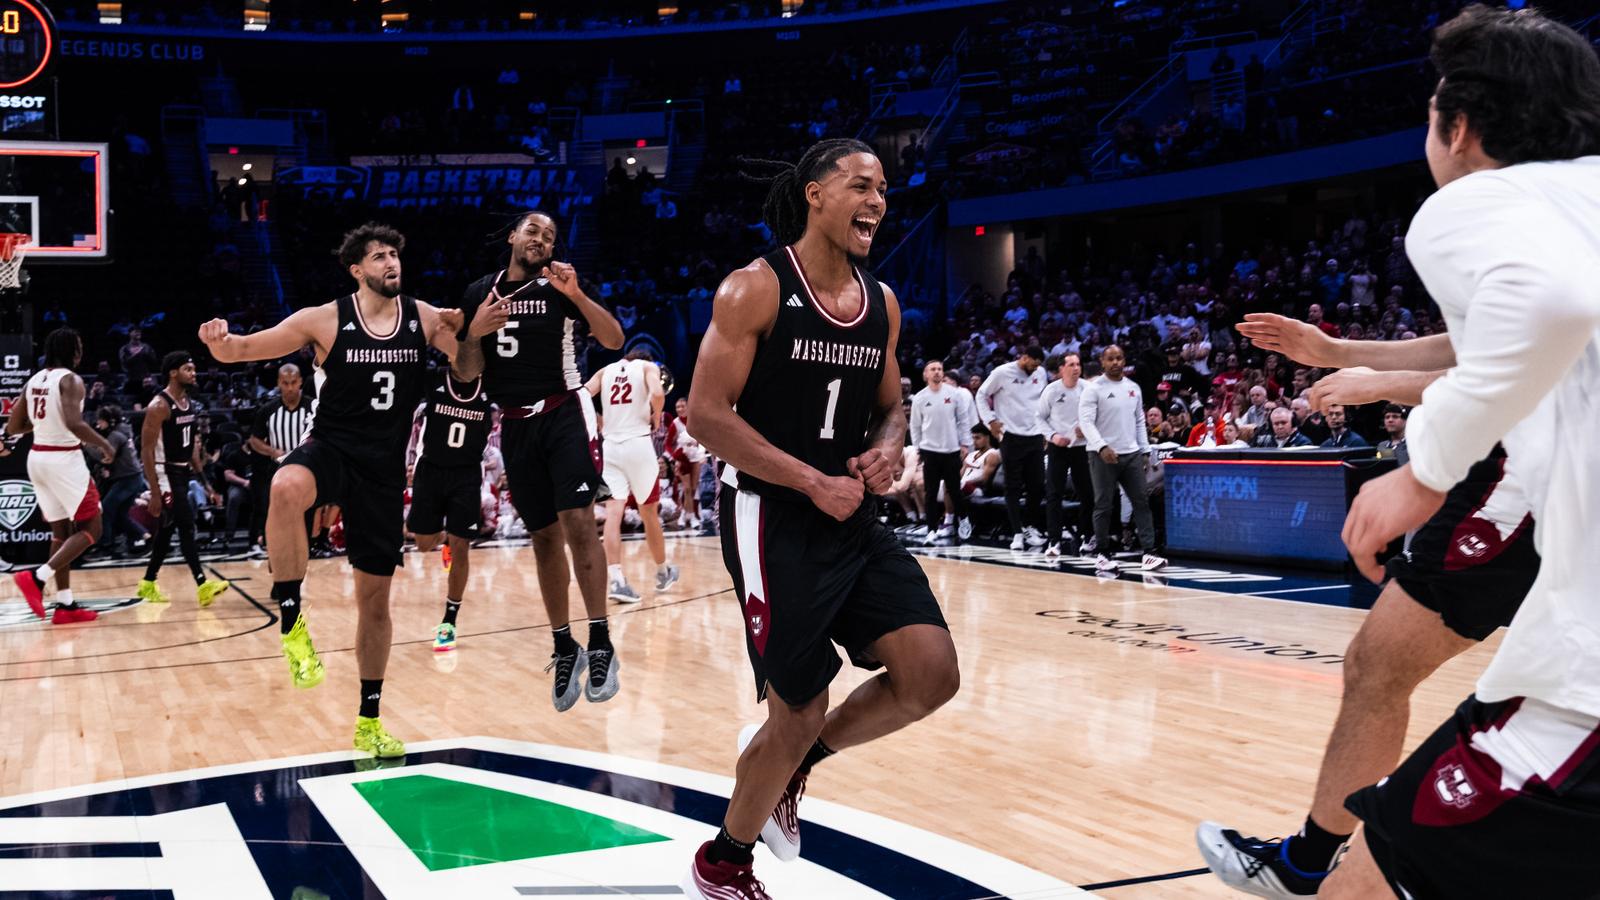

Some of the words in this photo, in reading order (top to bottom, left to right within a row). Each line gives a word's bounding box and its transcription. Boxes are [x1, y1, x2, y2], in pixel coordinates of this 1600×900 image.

[61, 40, 143, 59] EGENDS
[151, 43, 205, 60] CLUB
[382, 168, 577, 193] BASKETBALL
[496, 321, 520, 357] 5
[346, 349, 419, 363] MASSACHUSETTS
[791, 338, 881, 369] MASSACHUSETTS
[371, 371, 395, 410] 3
[610, 382, 632, 405] 22
[33, 397, 46, 419] 13
[435, 403, 485, 421] MASSACHUSETTS
[820, 379, 842, 439] 1
[182, 425, 191, 448] 11
[447, 422, 466, 448] 0
[1171, 475, 1258, 500] CHAMPION
[1172, 497, 1205, 519] HAS
[1208, 498, 1220, 520] A
[11, 528, 54, 542] Union
[1035, 609, 1186, 635] Credit
[1176, 632, 1345, 664] Union
